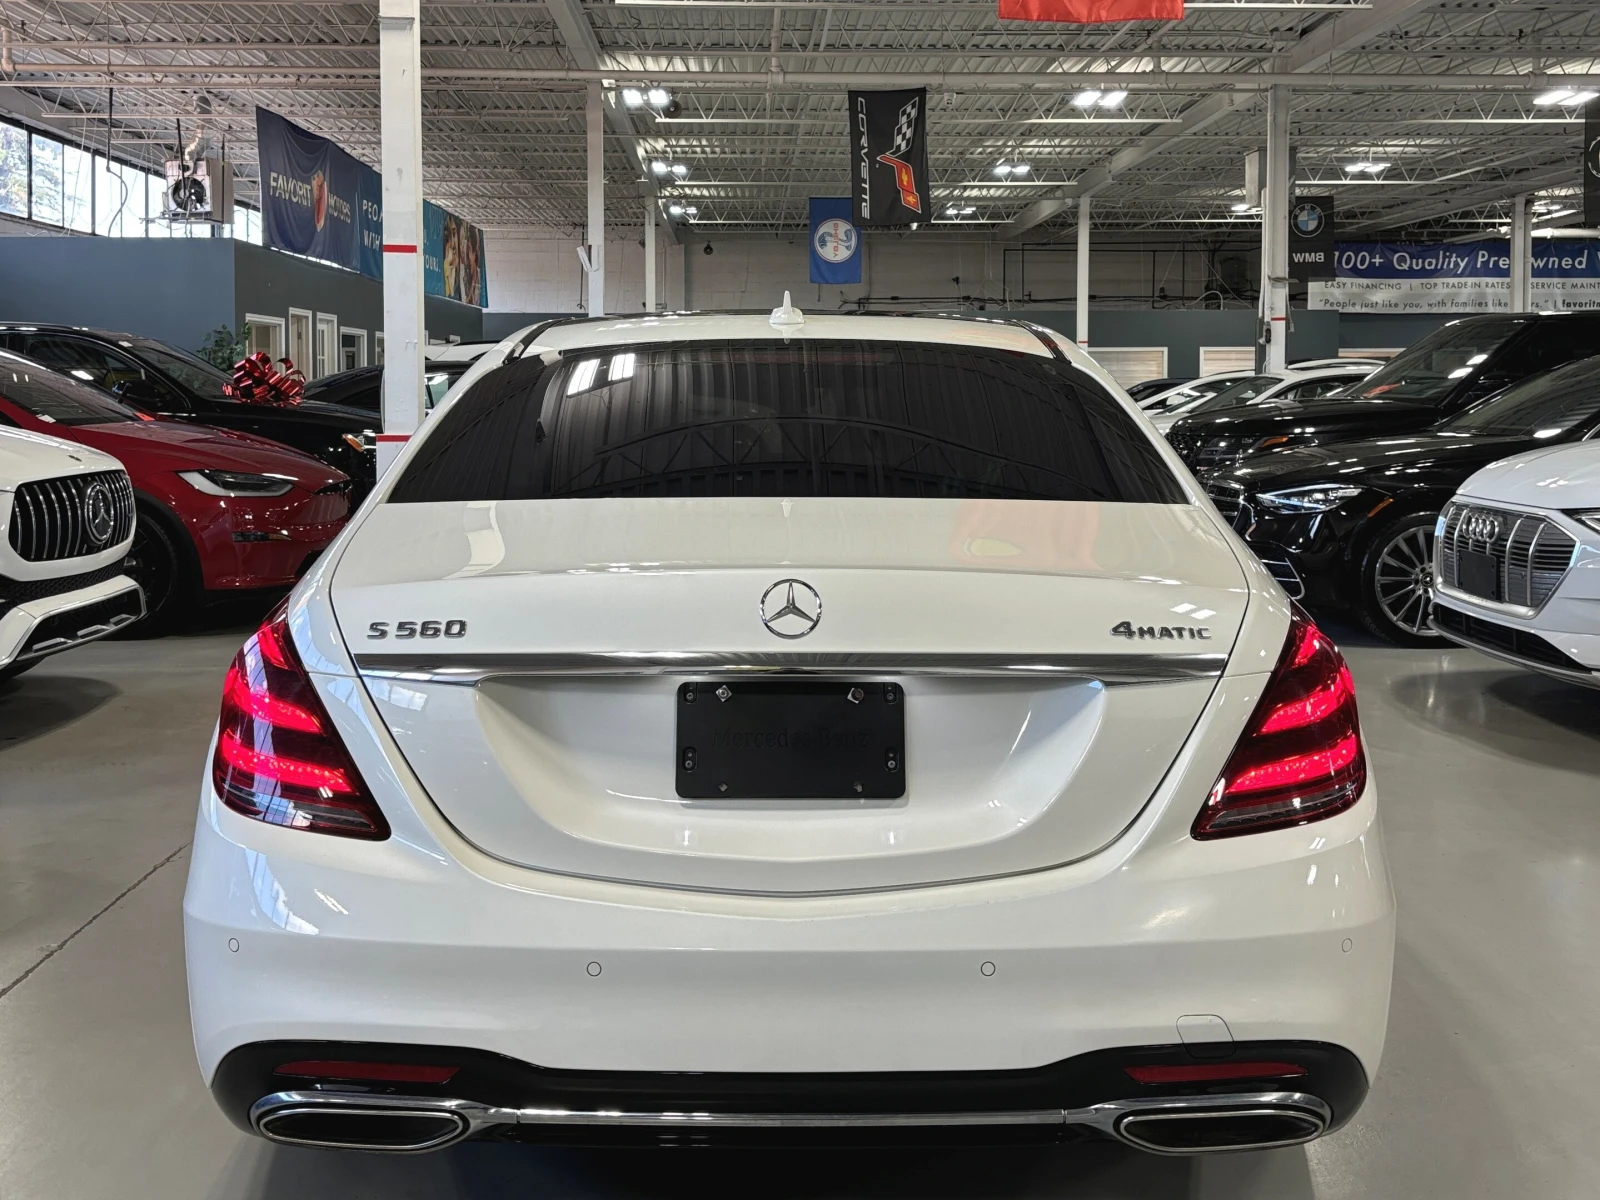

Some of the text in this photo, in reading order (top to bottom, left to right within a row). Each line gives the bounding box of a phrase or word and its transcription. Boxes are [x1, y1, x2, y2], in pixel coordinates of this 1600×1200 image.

[858, 97, 870, 220] CORVETTE
[270, 171, 311, 207] FAVORIT
[362, 199, 383, 223] PEO
[1393, 250, 1469, 274] Quality
[1324, 281, 1347, 289] EASY
[1350, 282, 1402, 291] FINANCING
[1420, 282, 1438, 290] TOP
[1441, 281, 1481, 290] TRADE-IN
[1485, 281, 1511, 289] RATES
[1530, 281, 1567, 290] SERVICE
[1360, 300, 1379, 311] just
[1381, 300, 1399, 309] like
[1402, 301, 1423, 311] you,
[1427, 299, 1447, 308] with
[1450, 299, 1489, 308] families
[1491, 299, 1509, 308] like
[366, 619, 467, 640] S 560
[1110, 620, 1212, 640] 4MATIC
